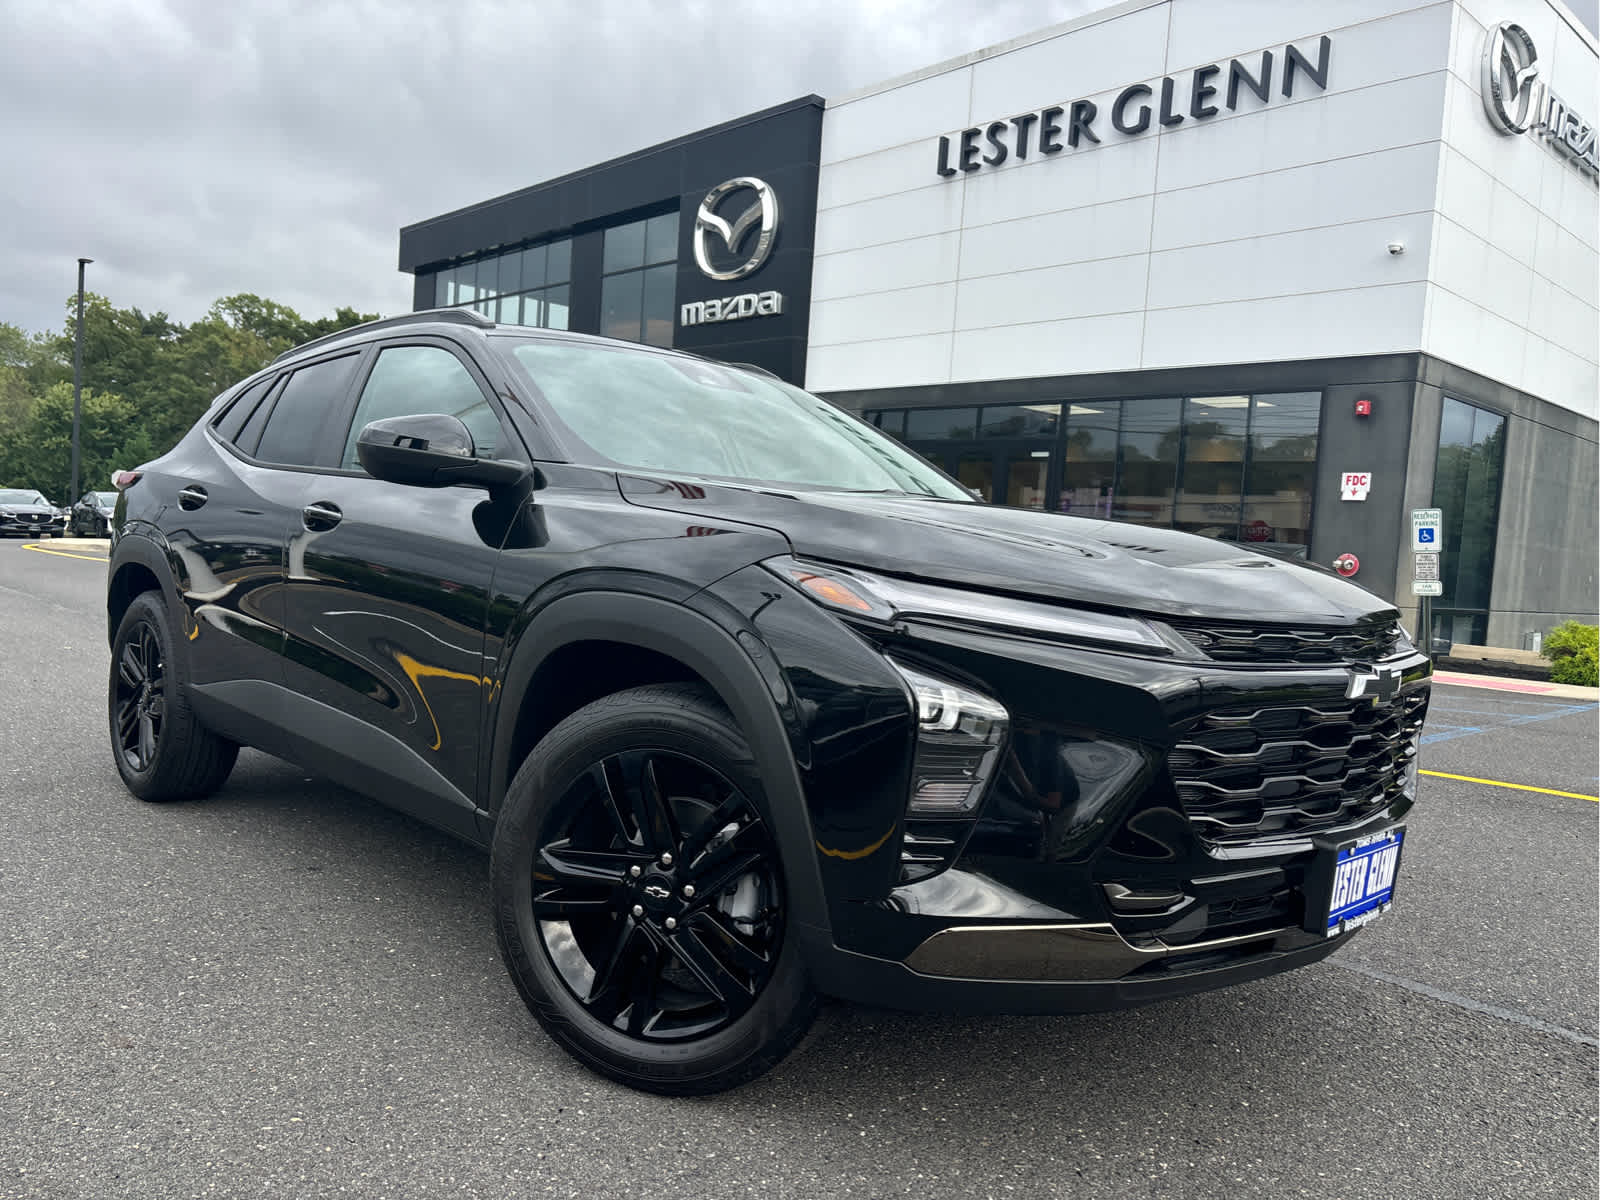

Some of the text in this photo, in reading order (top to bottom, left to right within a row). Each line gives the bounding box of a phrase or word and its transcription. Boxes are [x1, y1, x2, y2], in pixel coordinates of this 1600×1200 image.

[937, 35, 1331, 178] LESTER GLENN
[681, 290, 782, 327] mazda
[1345, 475, 1367, 486] FDC
[1329, 845, 1399, 912] LESTER GLENN
